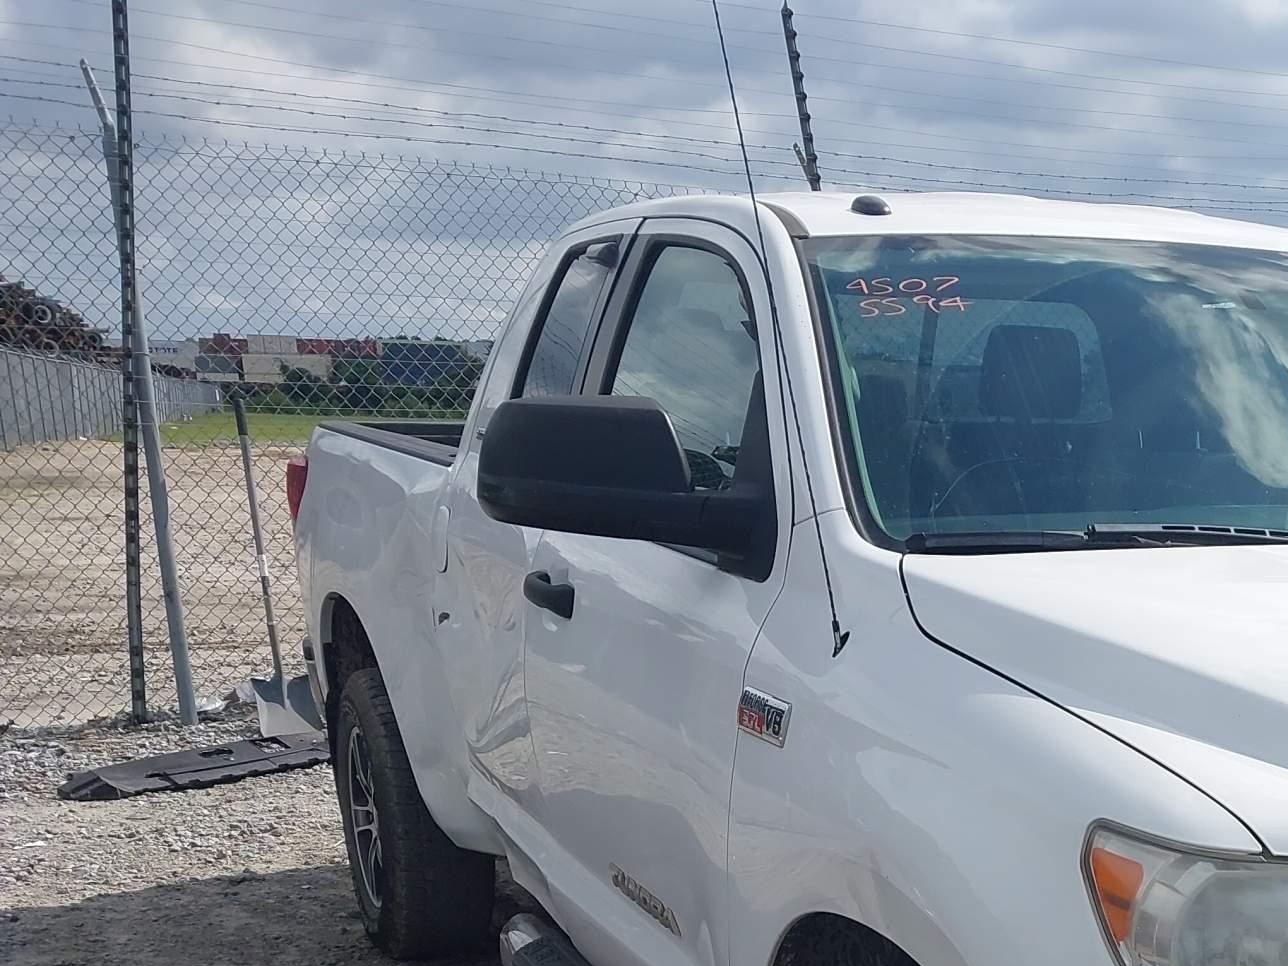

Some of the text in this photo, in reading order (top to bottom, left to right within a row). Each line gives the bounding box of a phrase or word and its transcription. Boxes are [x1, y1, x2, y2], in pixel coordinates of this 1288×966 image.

[846, 277, 960, 295] 4507
[859, 294, 976, 318] 5594
[765, 706, 786, 738] V8
